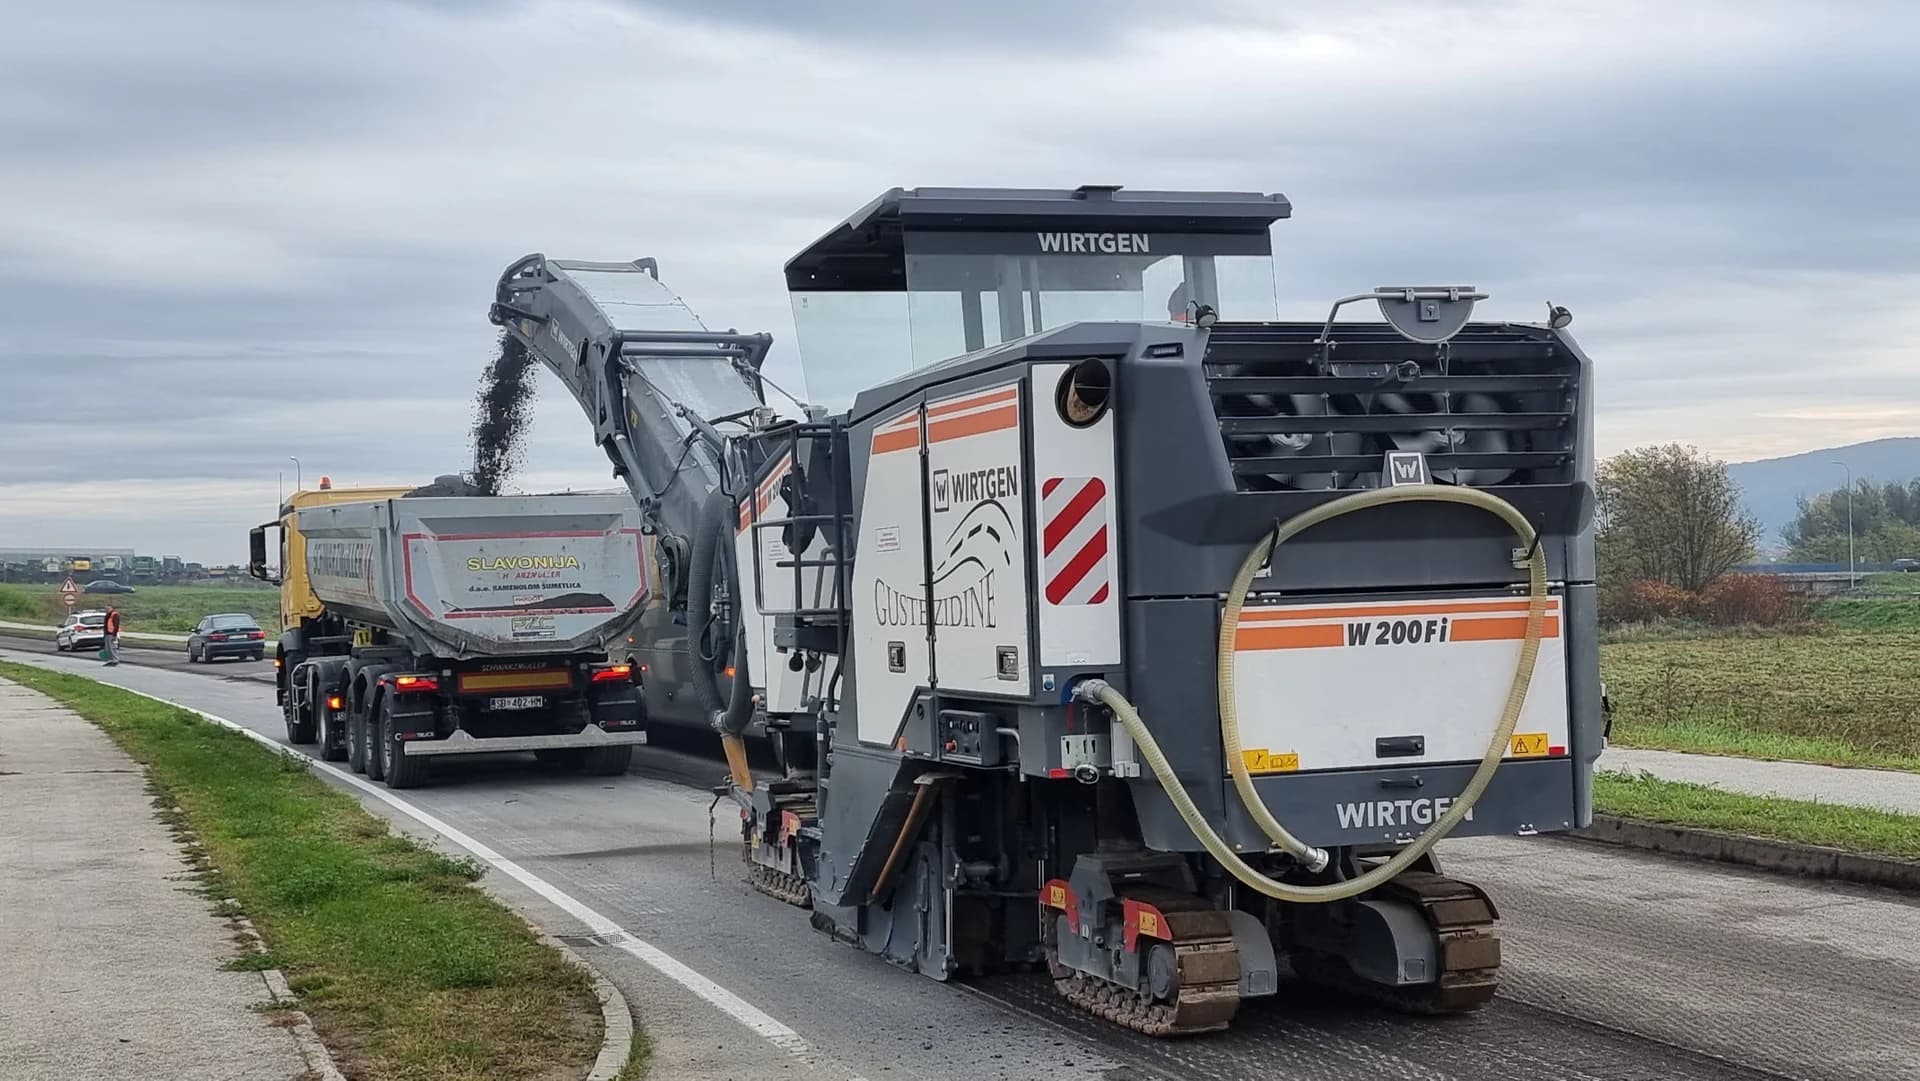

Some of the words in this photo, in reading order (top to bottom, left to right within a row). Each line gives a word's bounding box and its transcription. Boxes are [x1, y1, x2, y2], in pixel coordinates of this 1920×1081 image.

[1037, 232, 1149, 253] WIRTGEN
[952, 465, 1018, 503] WIRTGEN
[467, 556, 579, 571] SLAVONIJA
[1348, 622, 1371, 646] W
